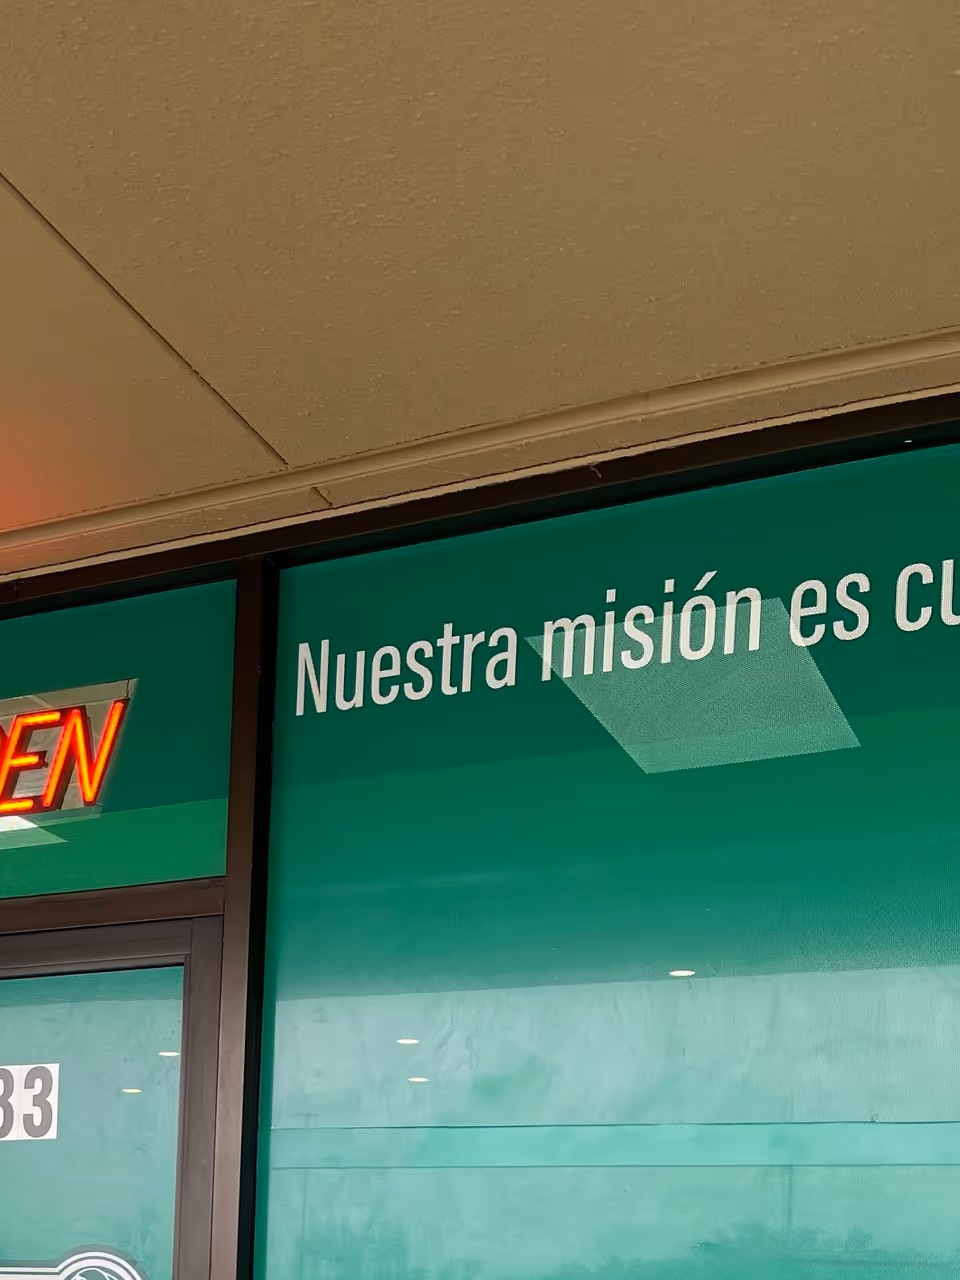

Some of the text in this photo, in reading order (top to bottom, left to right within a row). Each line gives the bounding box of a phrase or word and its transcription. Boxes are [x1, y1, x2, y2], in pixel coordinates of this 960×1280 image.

[295, 623, 517, 715] Nuestra
[541, 570, 762, 681] misión
[789, 572, 870, 647] es
